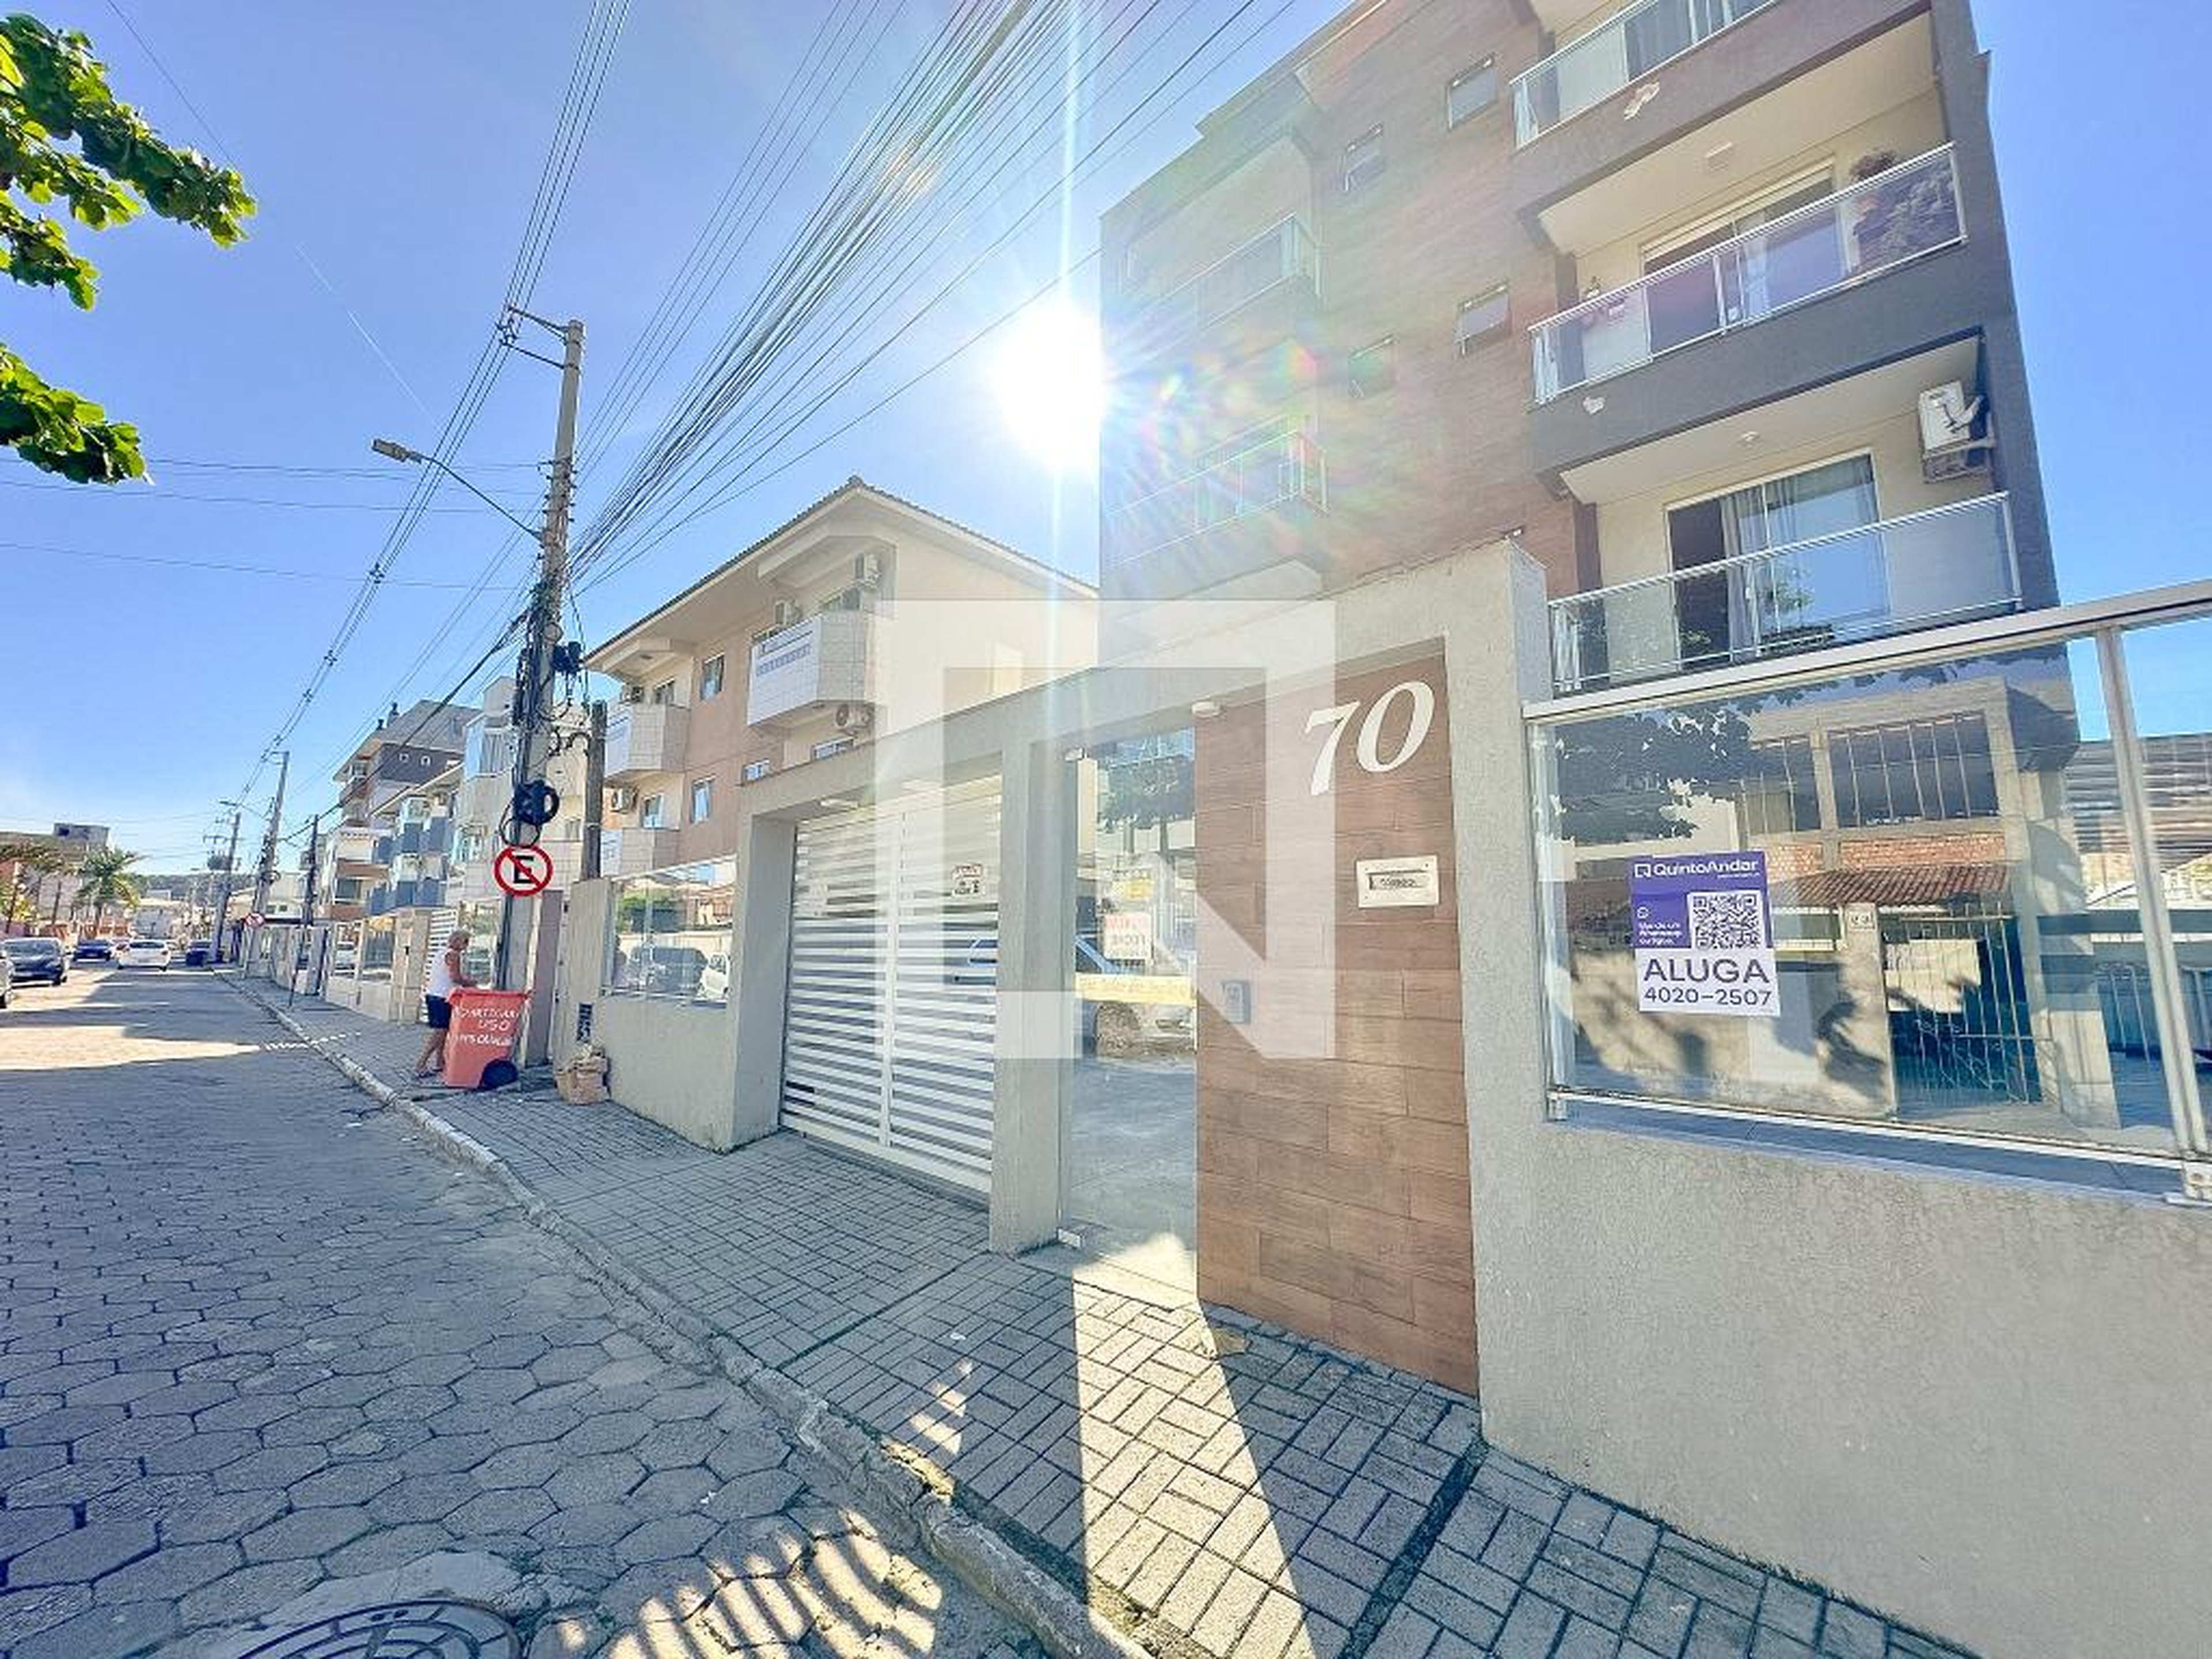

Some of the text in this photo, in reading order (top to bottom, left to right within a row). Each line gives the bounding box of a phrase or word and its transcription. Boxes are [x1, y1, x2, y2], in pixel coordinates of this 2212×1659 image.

[1304, 681, 1435, 795] 70
[514, 855, 534, 883] E
[1654, 859, 1758, 876] QuintoAndar
[1644, 959, 1770, 983] ALUGA
[1645, 987, 1772, 1005] 4020-2507
